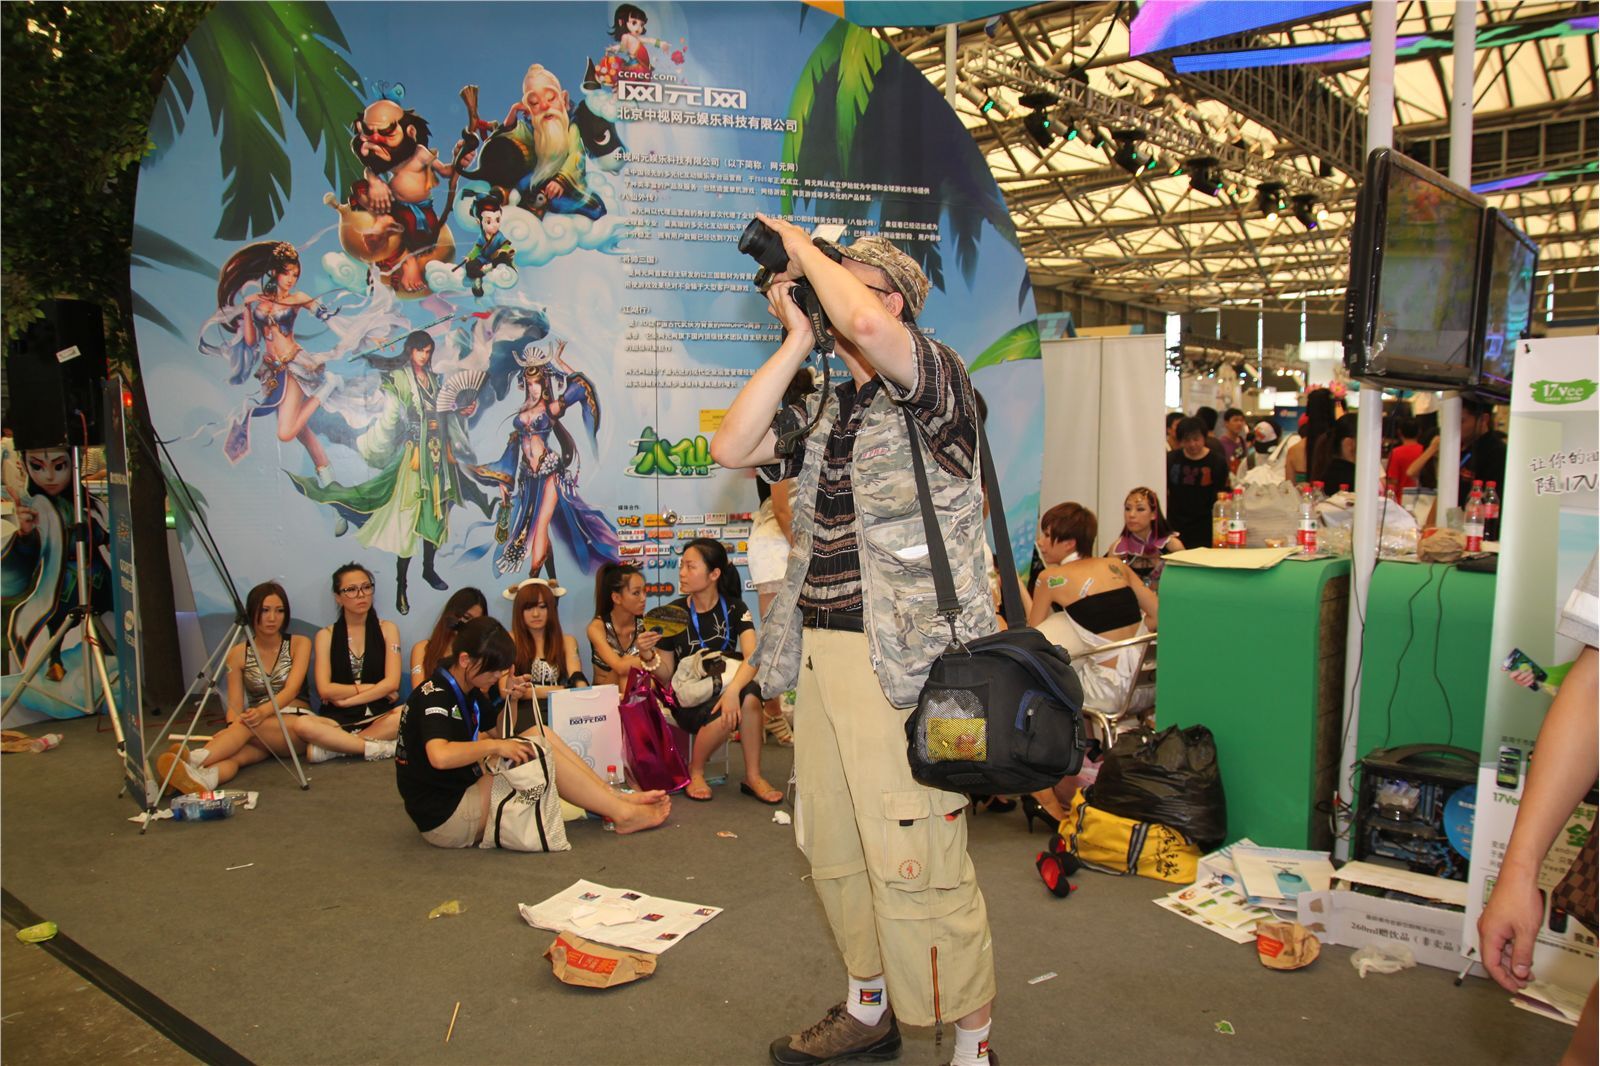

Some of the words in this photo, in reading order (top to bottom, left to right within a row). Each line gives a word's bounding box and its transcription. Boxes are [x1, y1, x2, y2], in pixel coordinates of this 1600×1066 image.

[618, 70, 677, 81] ccnec.com
[617, 79, 747, 109] 网元网
[617, 106, 798, 133] 北京中视网元娱乐科技有限公司
[811, 312, 826, 342] Nikon
